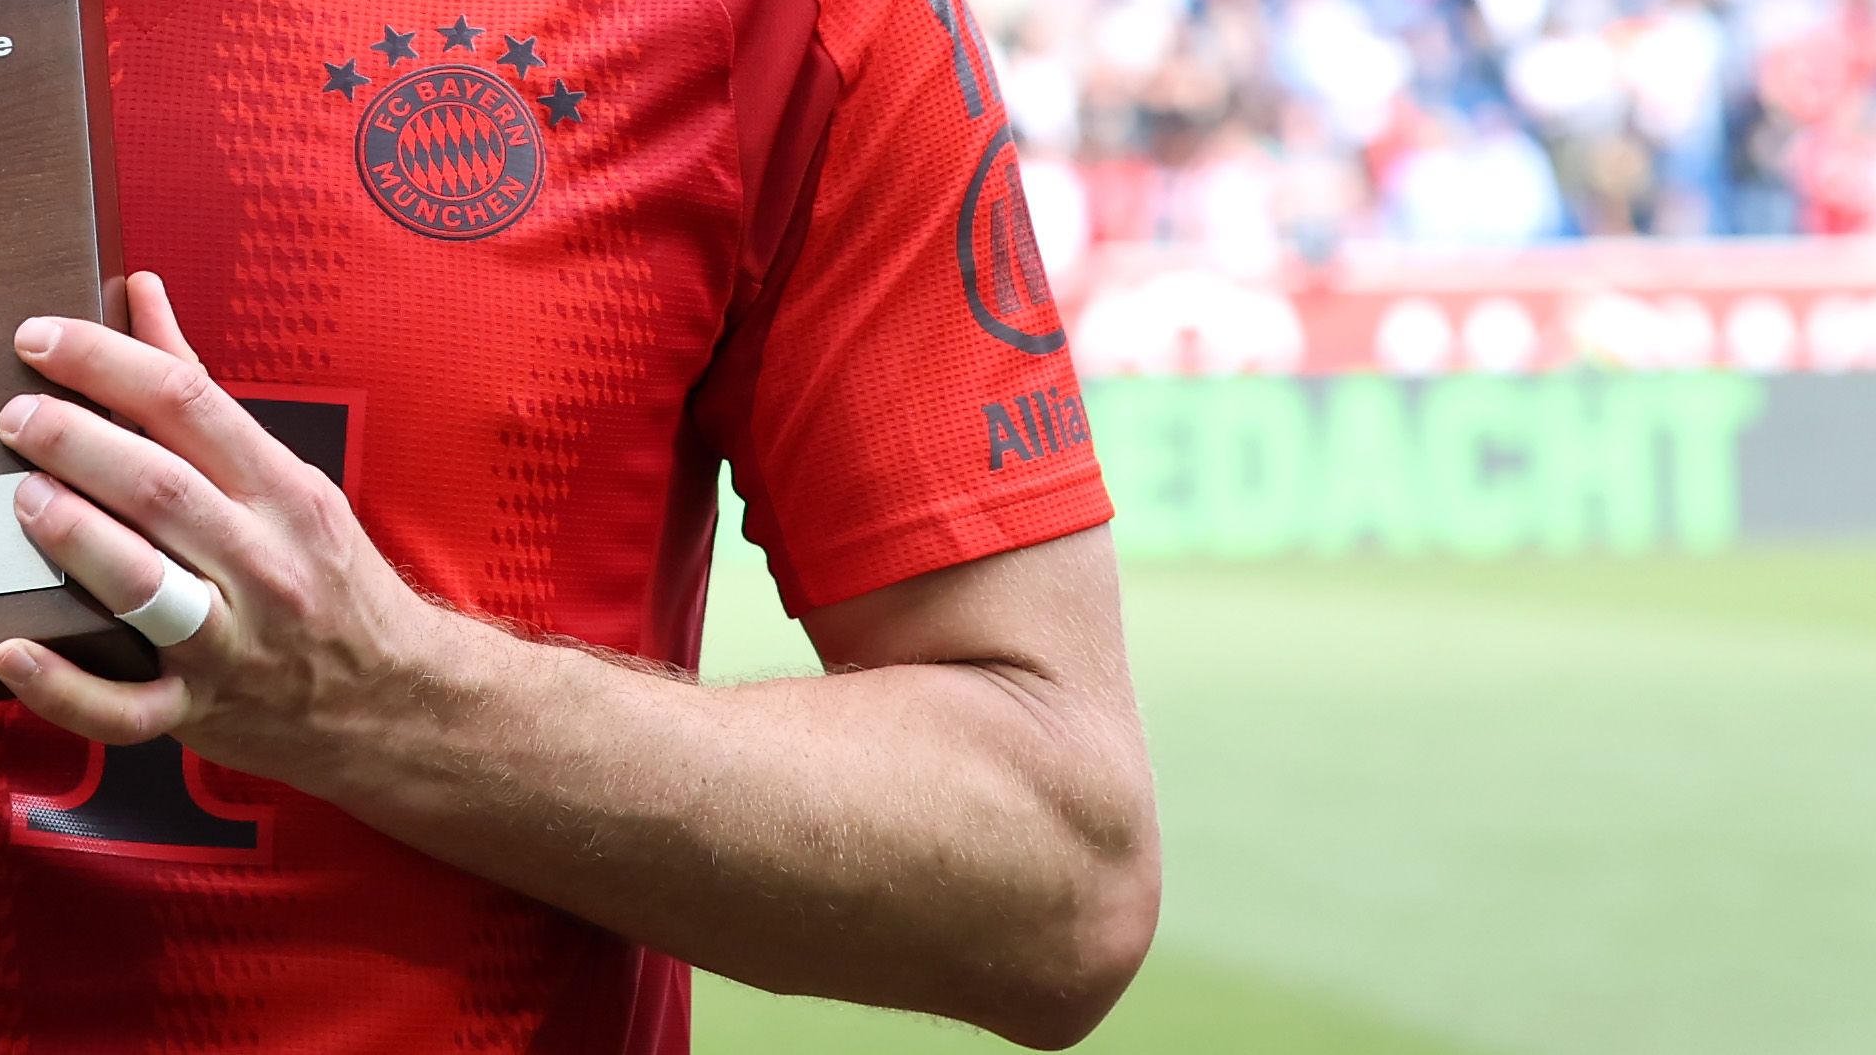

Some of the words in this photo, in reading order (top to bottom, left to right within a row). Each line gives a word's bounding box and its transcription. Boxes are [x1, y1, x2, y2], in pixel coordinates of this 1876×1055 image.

[375, 97, 412, 134] FC
[414, 78, 530, 147] BAYERN
[373, 161, 526, 227] MÜNCHEN
[981, 386, 1092, 471] Allia
